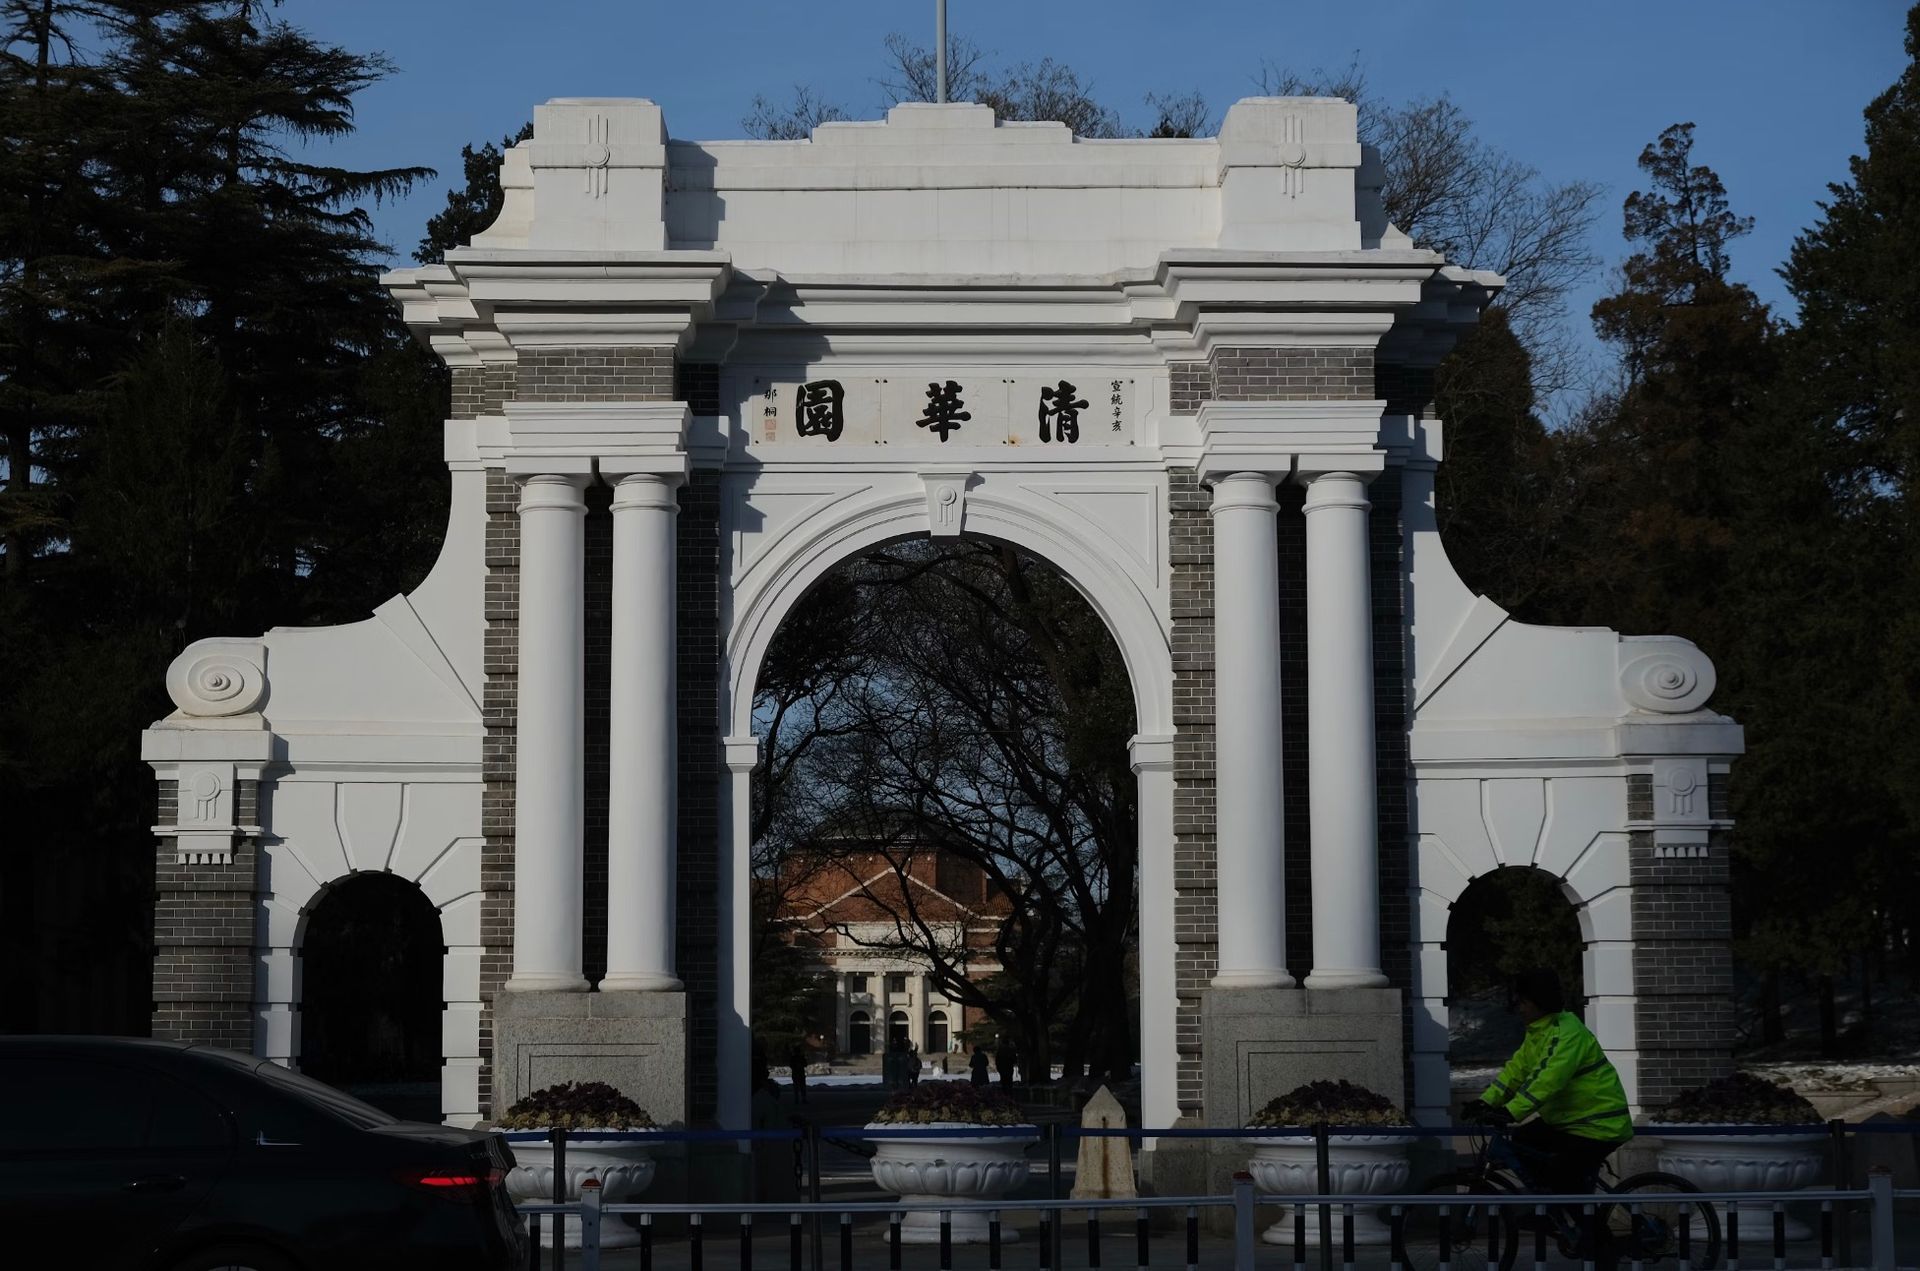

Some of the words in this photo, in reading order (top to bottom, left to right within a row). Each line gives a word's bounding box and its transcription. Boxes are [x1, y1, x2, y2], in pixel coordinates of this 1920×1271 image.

[763, 388, 778, 417] 那桐
[796, 379, 1090, 444] 清華園
[1110, 379, 1124, 432] 宣統辛亥
